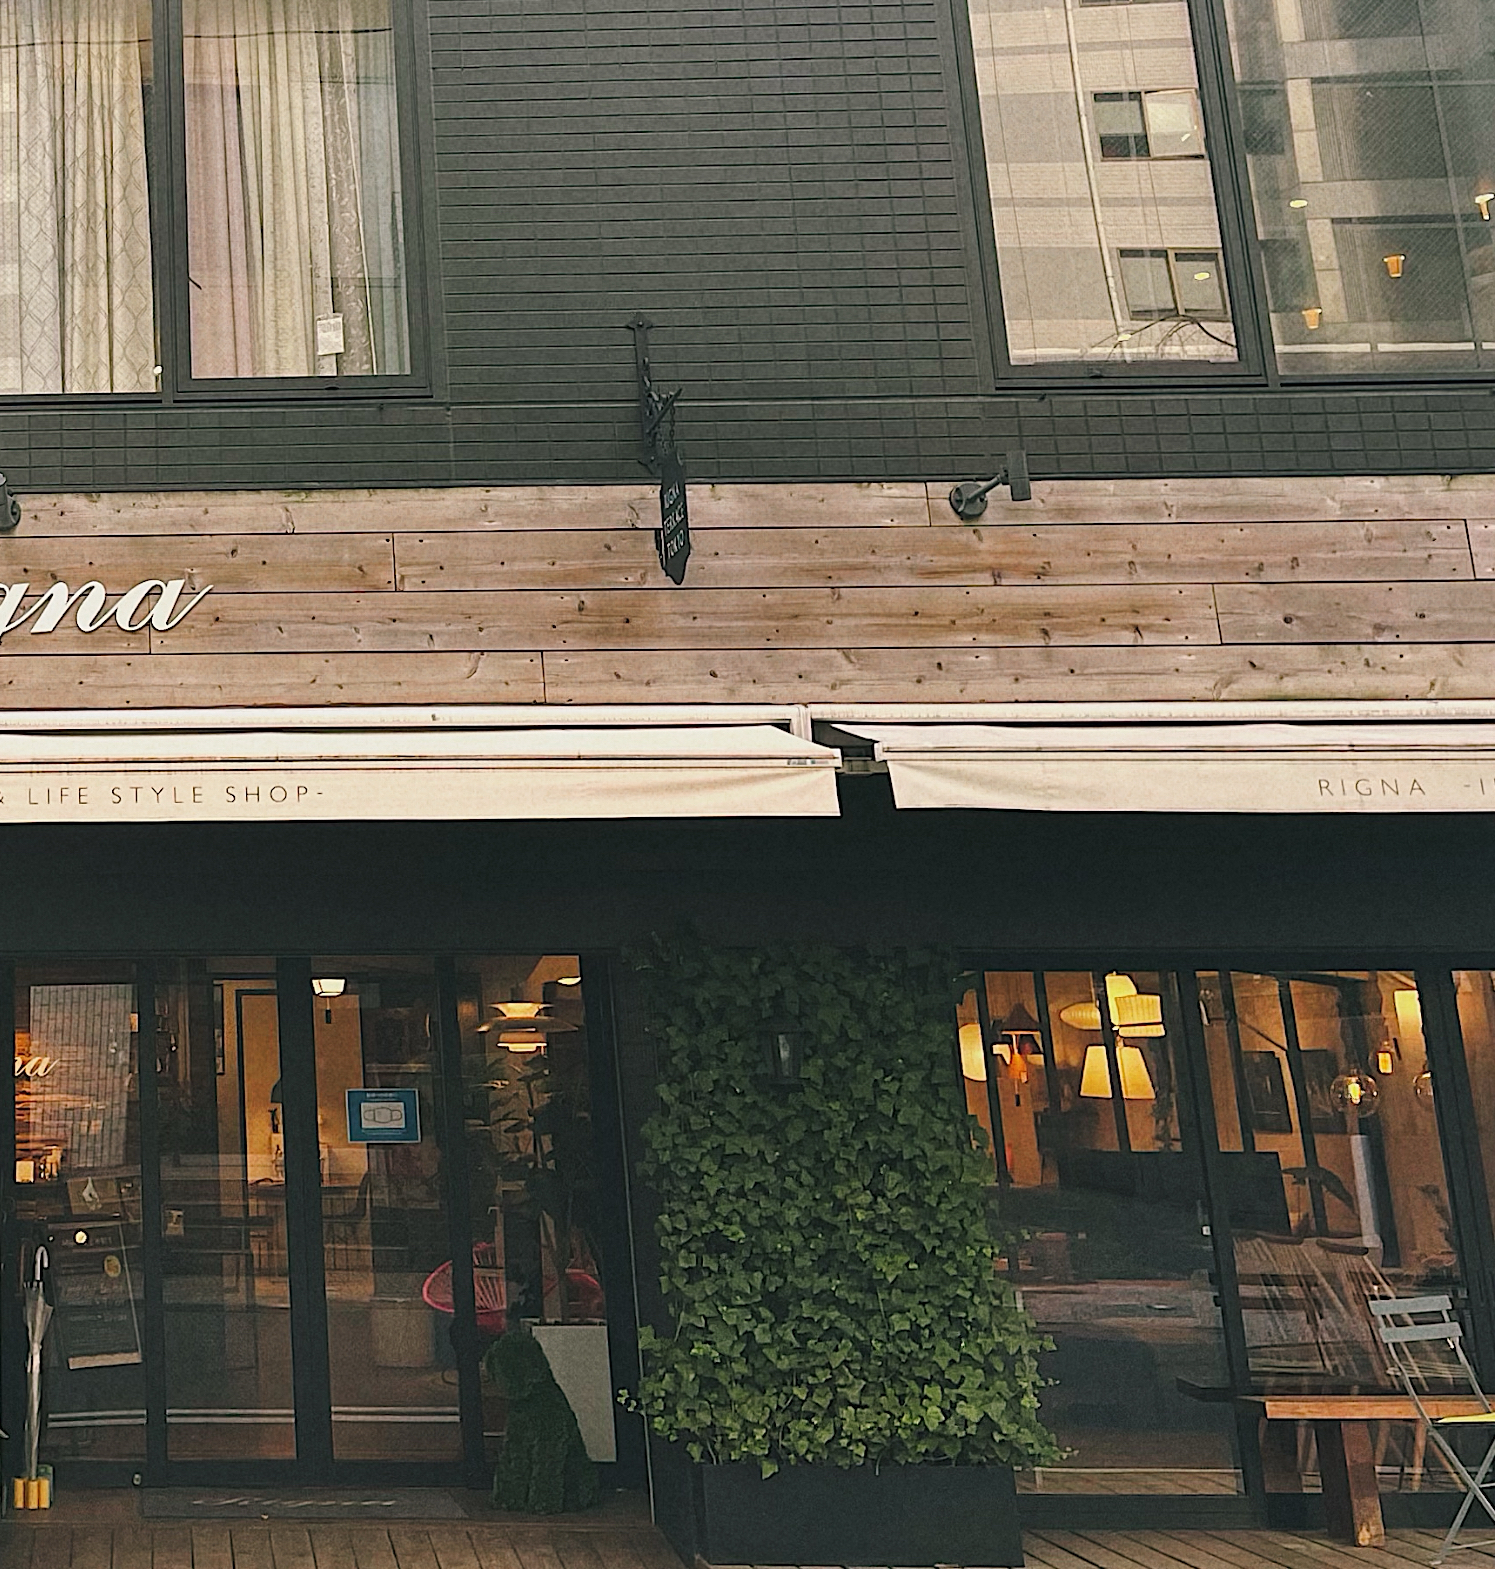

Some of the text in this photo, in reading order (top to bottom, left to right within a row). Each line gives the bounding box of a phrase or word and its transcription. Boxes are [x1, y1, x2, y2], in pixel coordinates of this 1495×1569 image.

[28, 787, 88, 806] LIFE
[111, 786, 204, 804] STYLE
[225, 785, 324, 804] SHOP-
[1317, 778, 1426, 797] RIGNA
